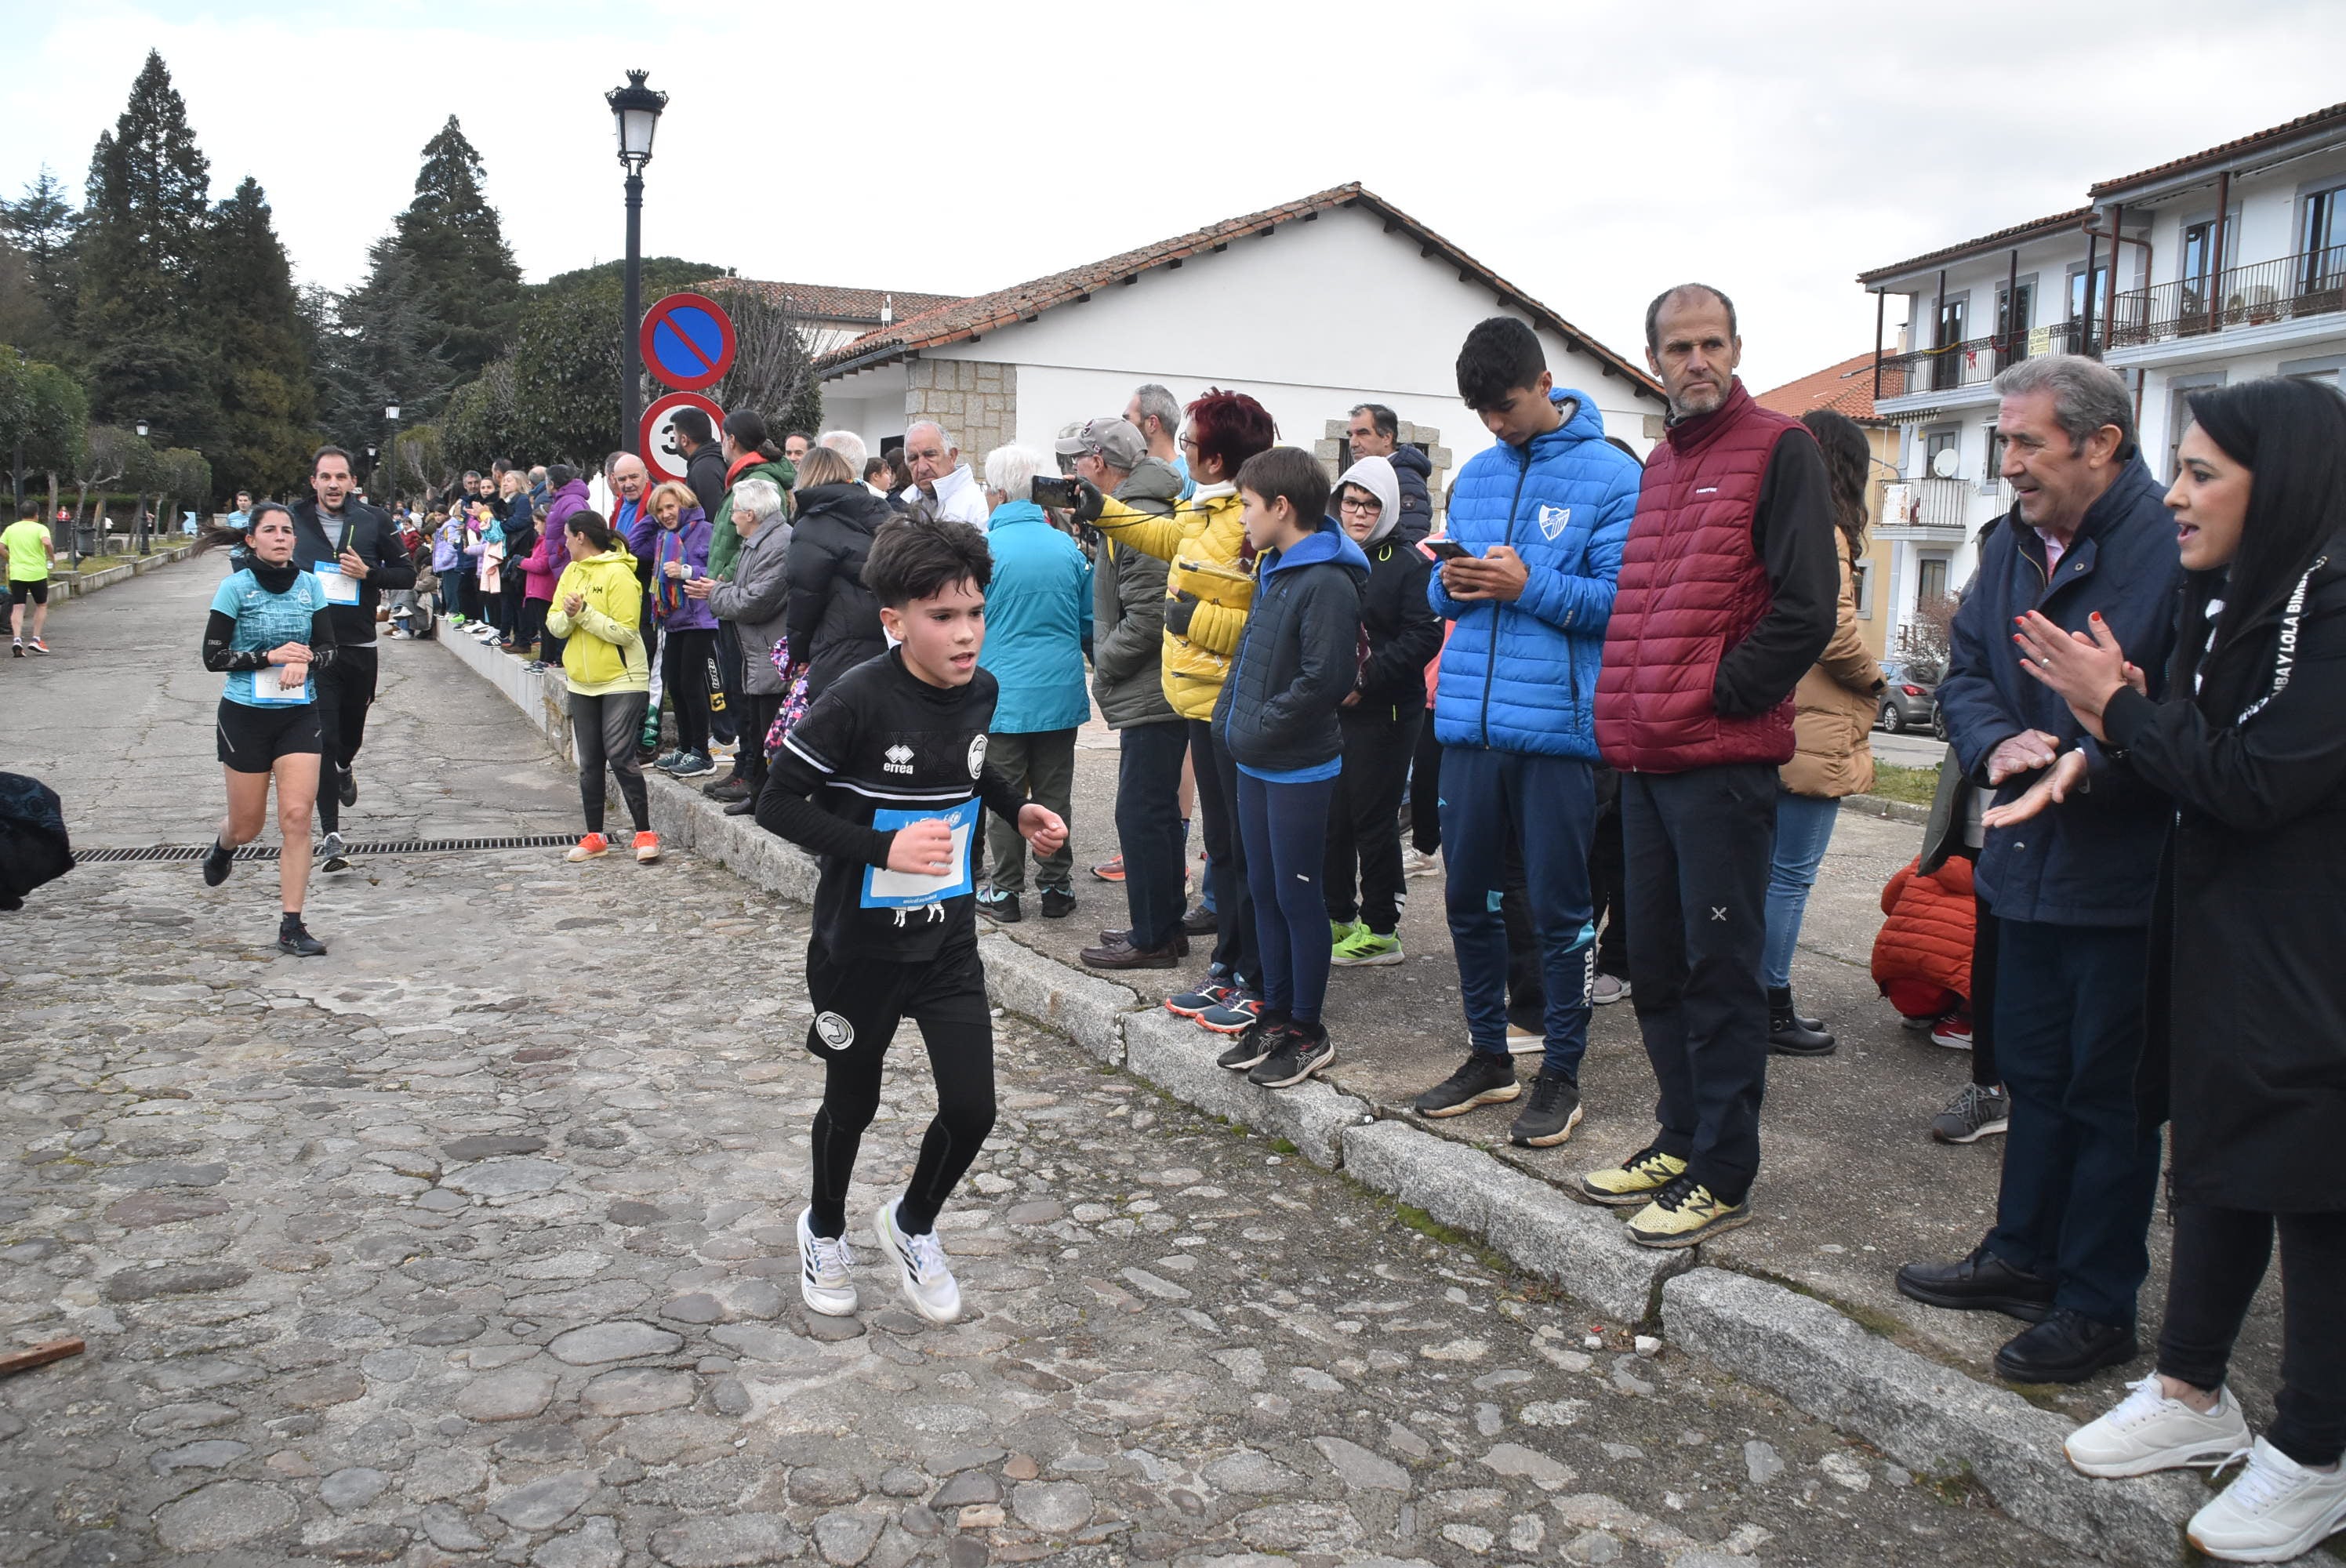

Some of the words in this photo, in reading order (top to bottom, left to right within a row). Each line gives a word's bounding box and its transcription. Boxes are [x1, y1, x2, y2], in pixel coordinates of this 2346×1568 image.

[2279, 616, 2300, 652] LOLA
[707, 658, 720, 689] lotto
[2276, 653, 2293, 665] Y
